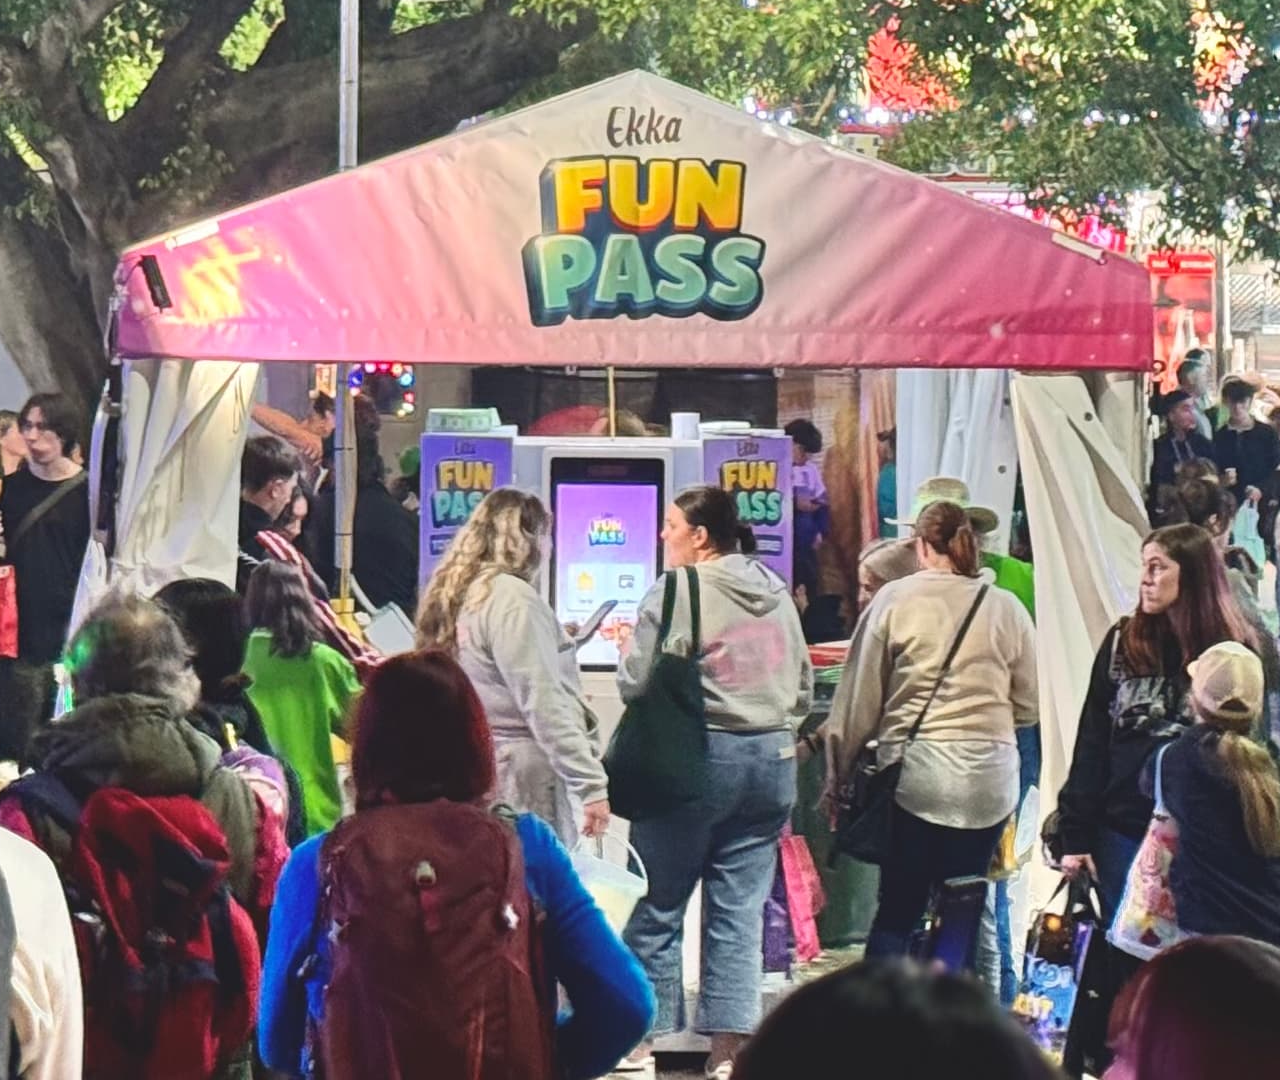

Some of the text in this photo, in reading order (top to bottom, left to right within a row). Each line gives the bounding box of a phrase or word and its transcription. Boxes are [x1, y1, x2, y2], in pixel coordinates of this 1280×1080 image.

[606, 106, 683, 149] Ekka
[544, 156, 746, 236] FUN
[528, 233, 765, 320] PASS
[436, 458, 496, 491] FUN
[720, 460, 778, 491] FUN
[431, 490, 486, 526] PAS
[735, 490, 782, 524] ASS
[589, 531, 626, 545] PASS
[591, 519, 623, 533] FUN
